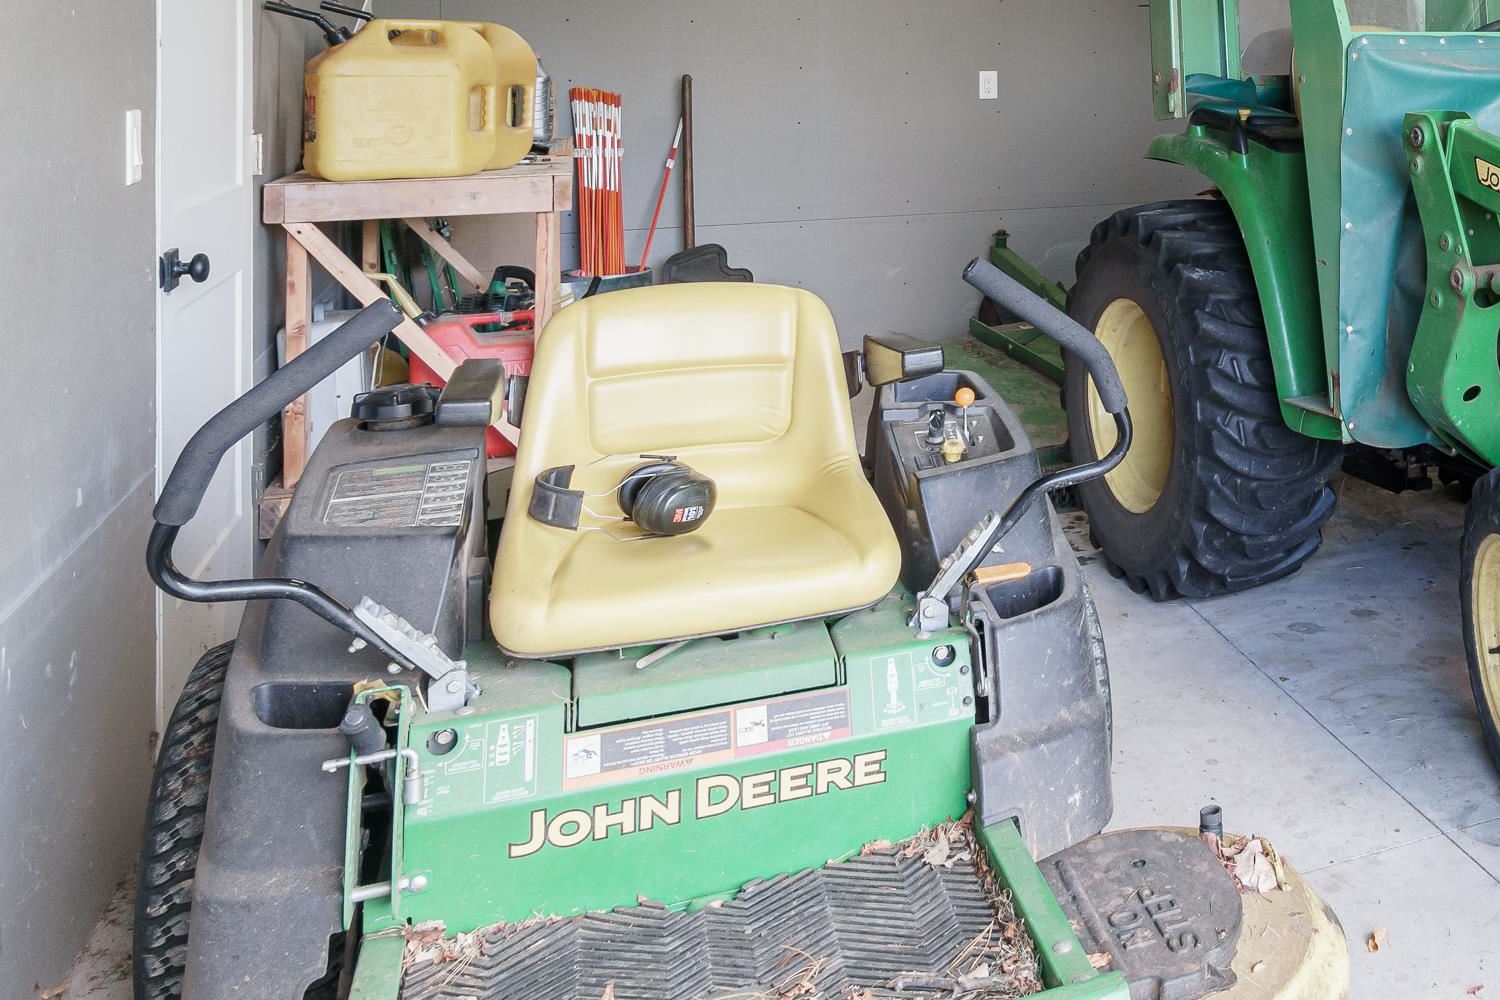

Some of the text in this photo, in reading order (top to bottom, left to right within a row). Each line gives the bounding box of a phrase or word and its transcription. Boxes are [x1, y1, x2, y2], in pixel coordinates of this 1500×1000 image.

[787, 733, 824, 746] DANGER
[639, 759, 688, 775] WARNING
[508, 749, 888, 859] JOHN DEERE
[1107, 909, 1157, 951] NO
[1137, 885, 1201, 953] STEP
